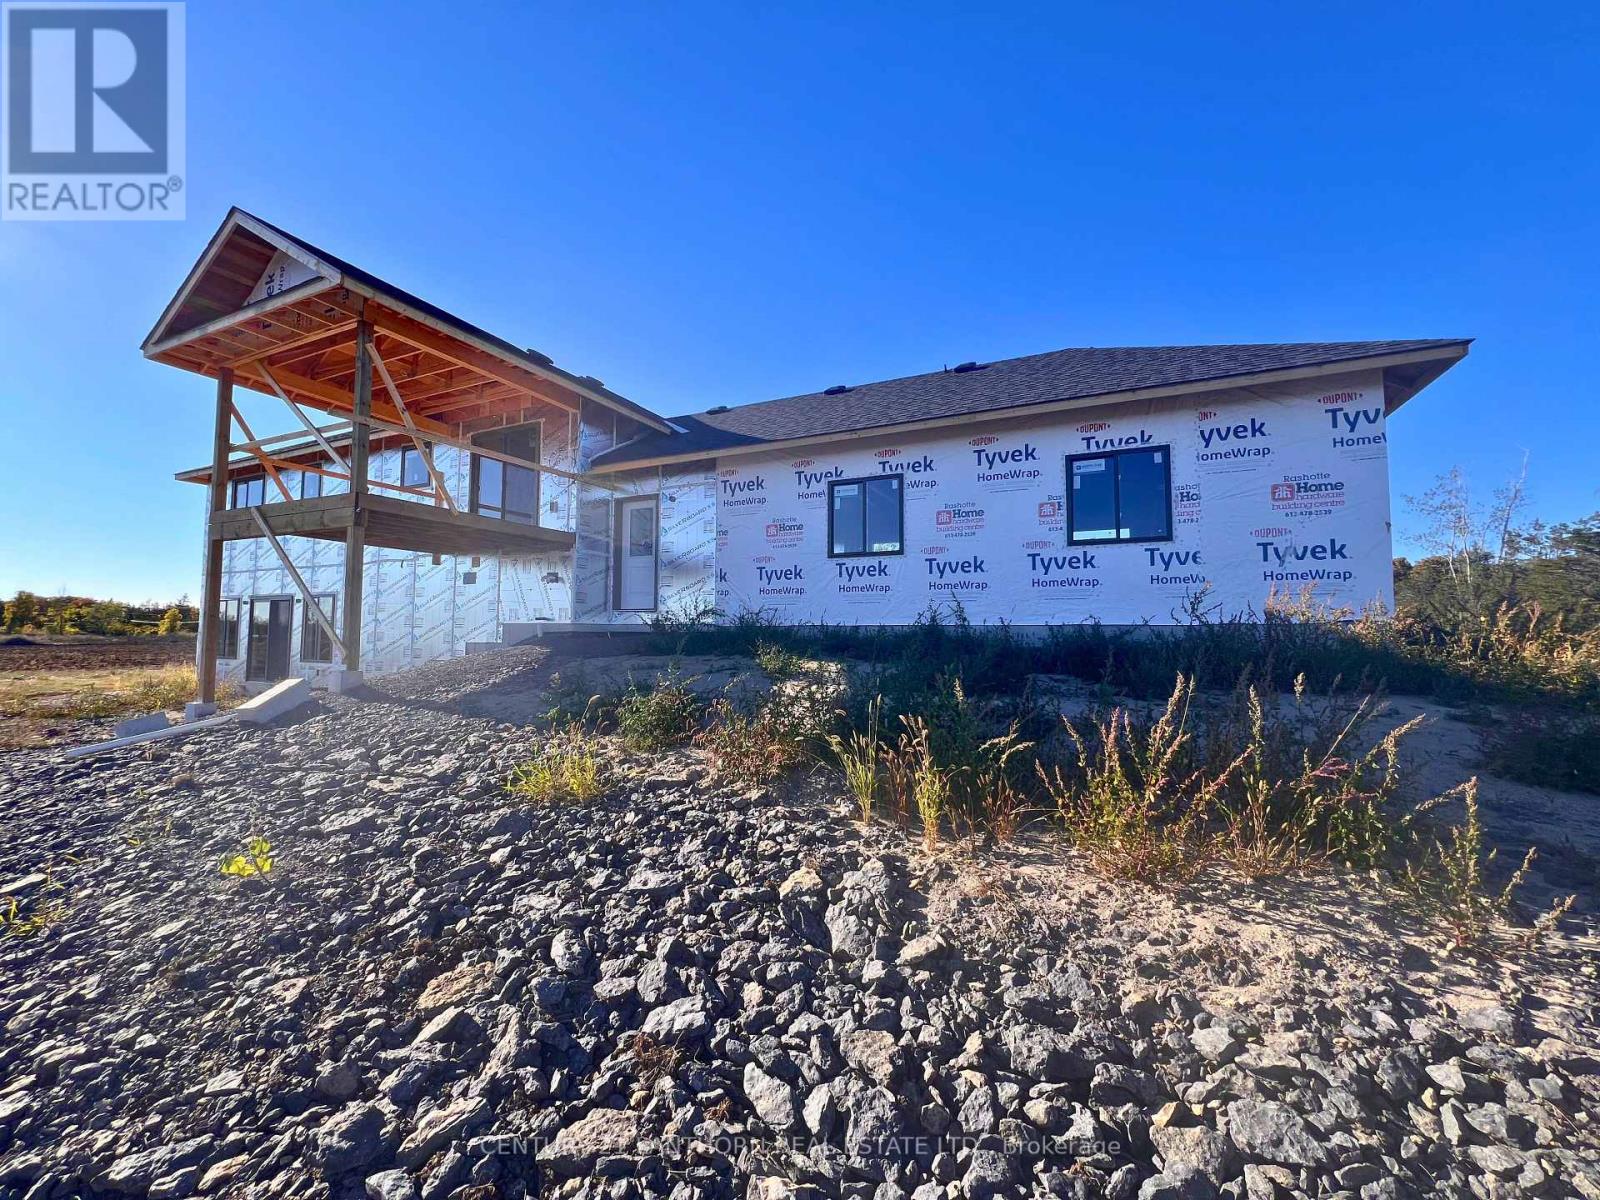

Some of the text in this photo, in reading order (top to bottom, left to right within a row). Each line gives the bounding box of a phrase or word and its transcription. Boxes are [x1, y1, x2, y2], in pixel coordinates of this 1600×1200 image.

[1322, 391, 1358, 404] DUPONT
[1080, 422, 1107, 433] DUPONT
[973, 443, 1037, 470] Tyvek
[795, 466, 844, 489] Tyvek
[977, 469, 1040, 482] HomeWrap
[1283, 472, 1331, 483] Rashotte
[720, 475, 765, 498] Tyvek
[1295, 481, 1344, 494] Home
[723, 496, 767, 507] HomeWrap
[952, 508, 985, 519] Home
[779, 522, 804, 532] Home
[1254, 527, 1288, 538] DUPONT
[1256, 538, 1348, 568] Tyvek
[924, 555, 985, 579] Tyvek
[1027, 550, 1096, 576] Tyvek
[756, 564, 803, 586] Tyvek
[835, 560, 888, 582] Tyvek
[1263, 569, 1353, 582] HomeWrap
[838, 583, 891, 594] HomeWrap
[928, 580, 988, 591] HomeWrap
[1032, 577, 1100, 588] HomeWrap
[759, 586, 805, 595] HomeWrap
